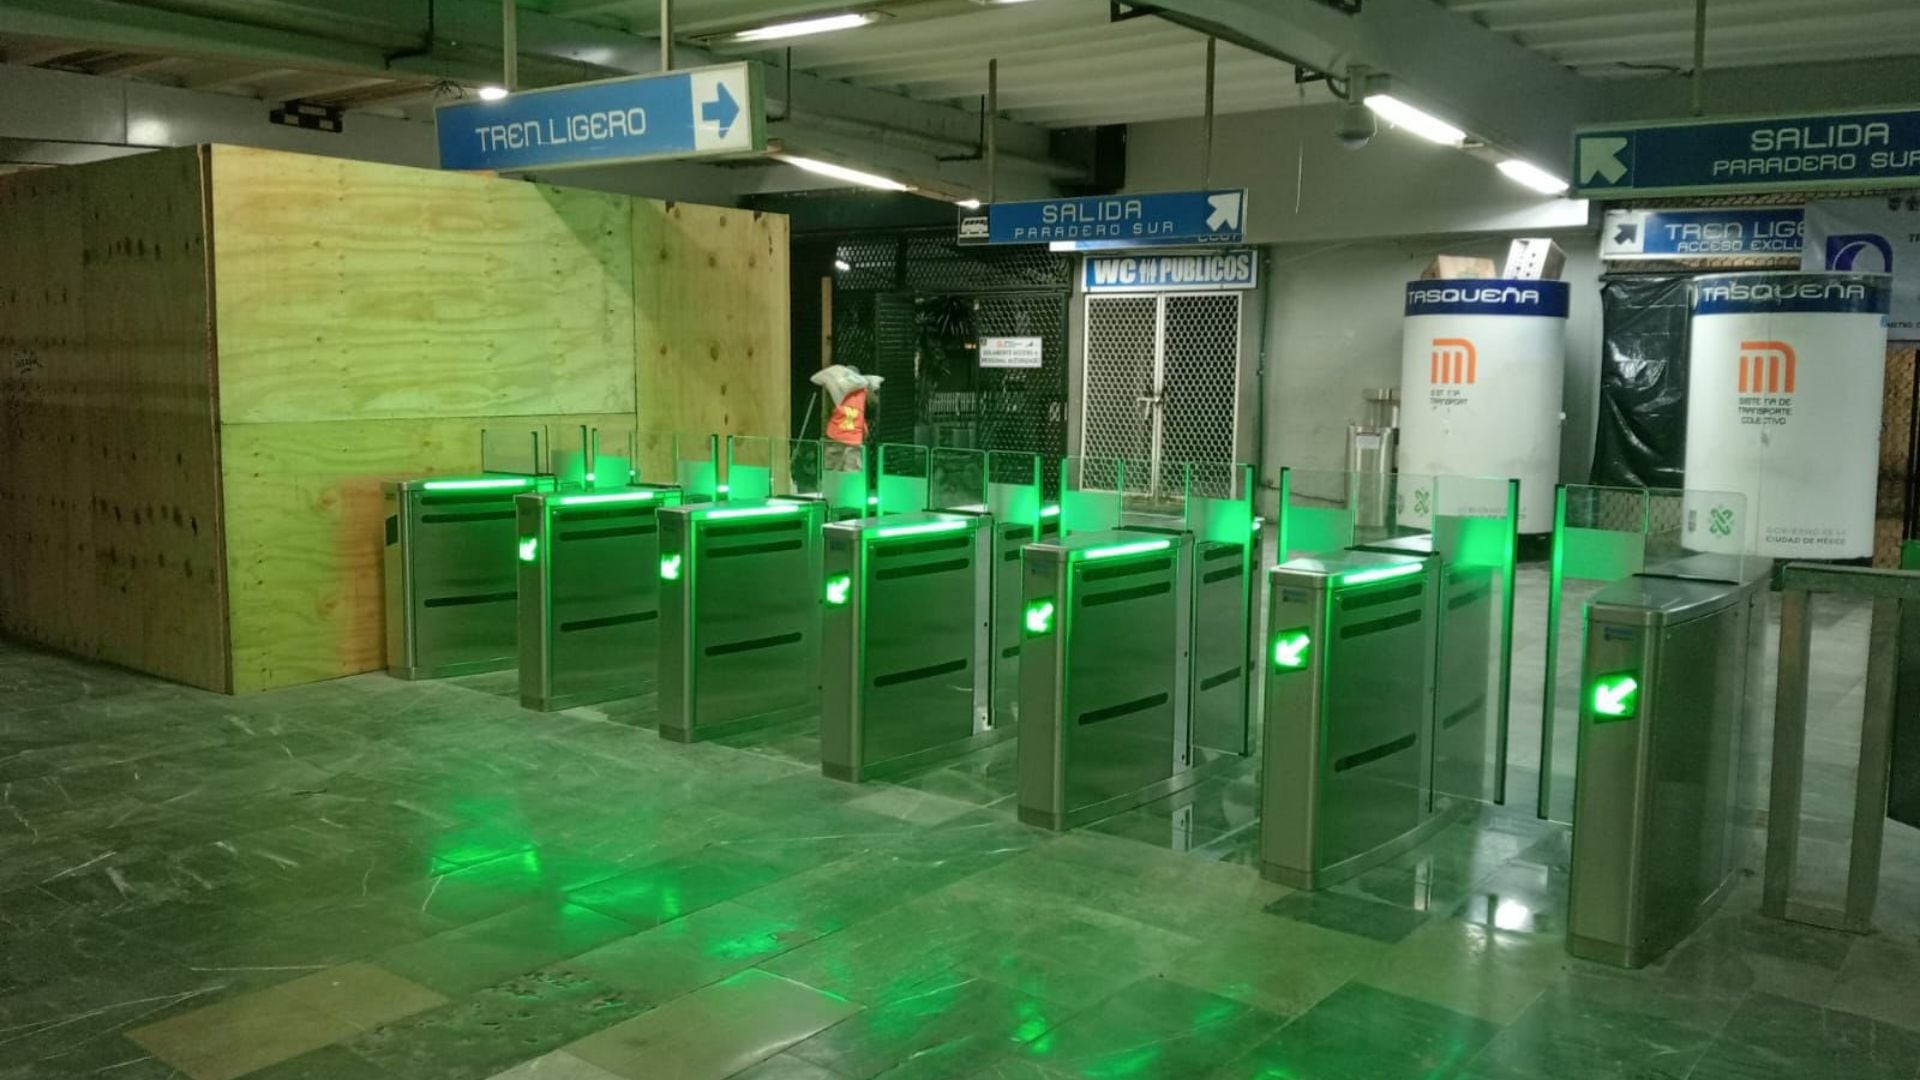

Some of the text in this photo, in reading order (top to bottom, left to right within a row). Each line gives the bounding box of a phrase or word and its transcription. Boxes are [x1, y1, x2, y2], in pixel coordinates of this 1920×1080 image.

[475, 107, 646, 152] TREN LIGERO
[1751, 122, 1890, 151] SALIDA
[1713, 153, 1856, 176] PARADERO
[1042, 201, 1142, 223] SALIDA
[1014, 221, 1174, 239] PARADERO SUR
[1664, 222, 1743, 240] TREN
[1677, 240, 1742, 252] ACCESO
[1094, 255, 1250, 284] WC PUBLICOS
[1408, 287, 1540, 304] TASQUEÑA
[1739, 407, 1792, 415] TRANSPORTE
